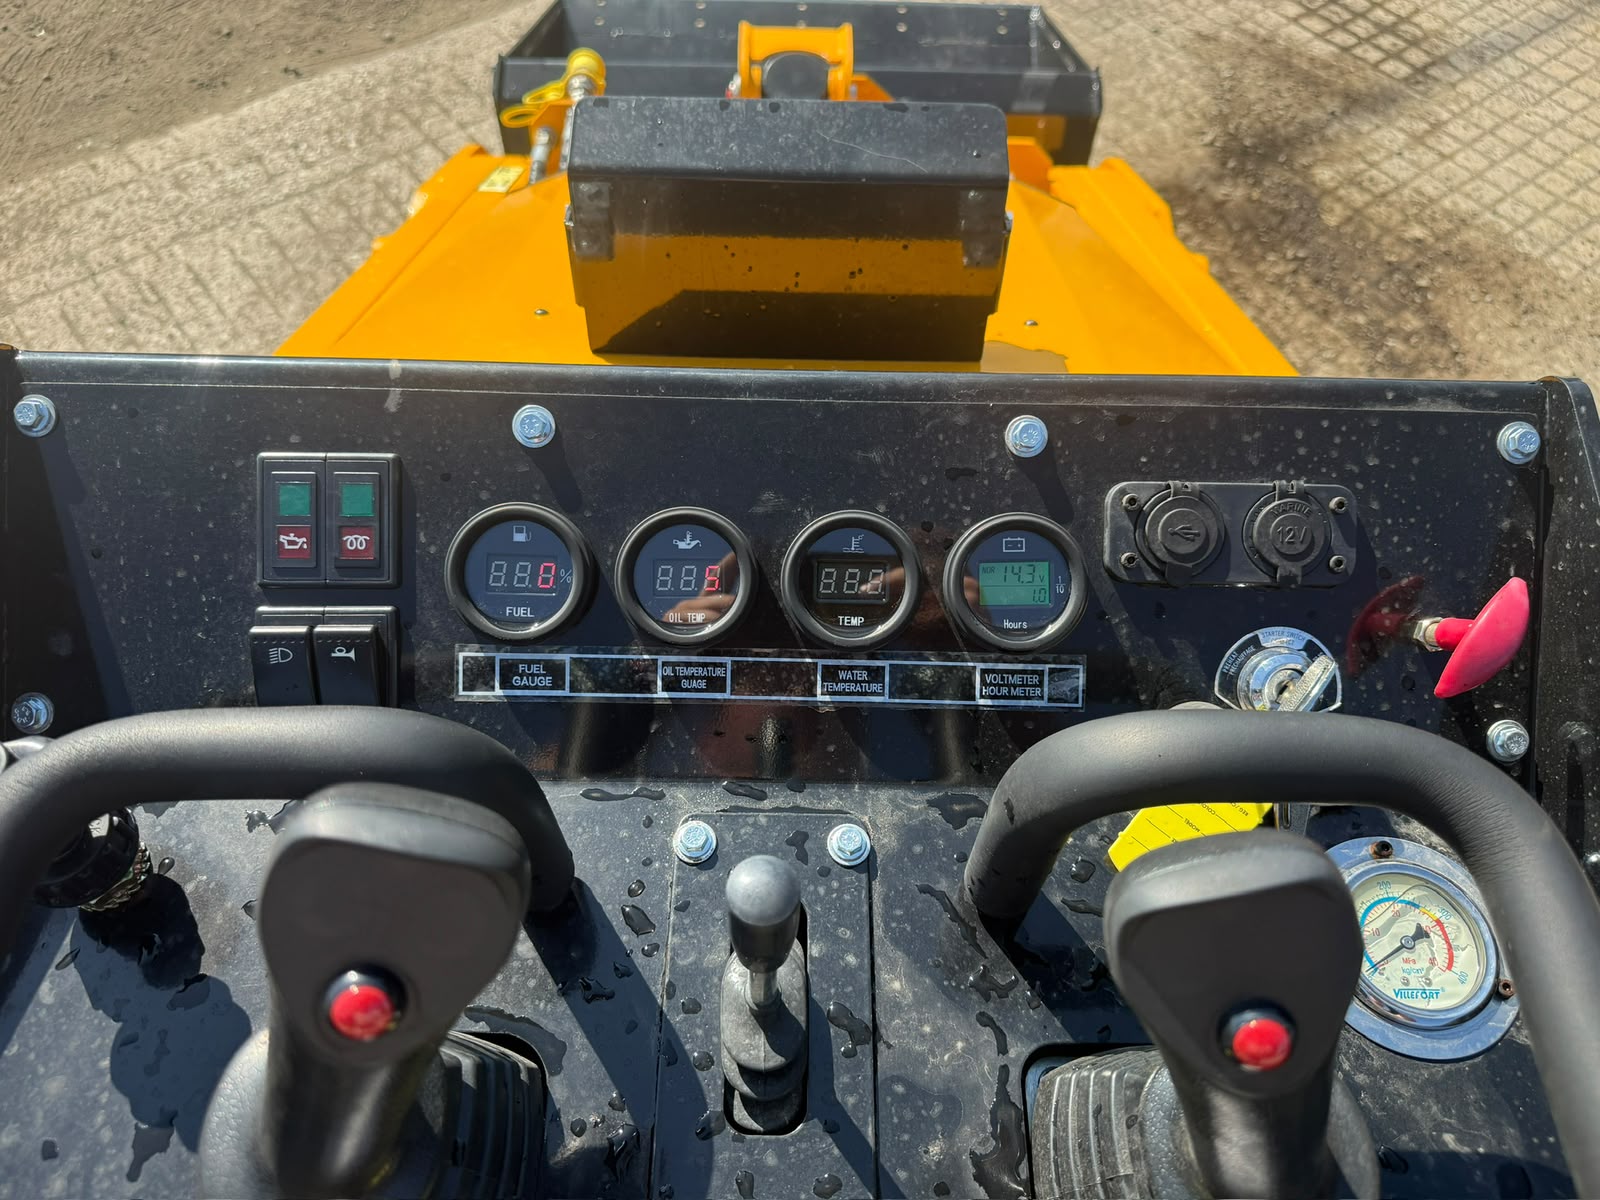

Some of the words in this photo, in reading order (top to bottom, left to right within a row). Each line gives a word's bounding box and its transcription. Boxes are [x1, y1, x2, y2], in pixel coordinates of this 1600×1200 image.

[1271, 502, 1312, 518] MARINE
[1276, 526, 1307, 545] 12V
[1003, 564, 1036, 584] 14.3
[506, 606, 535, 618] FUEL
[669, 612, 683, 623] OIL
[687, 612, 706, 623] TEMP
[838, 615, 865, 626] TEMP
[1003, 619, 1028, 629] Hours
[1262, 630, 1285, 638] STARTER
[1286, 631, 1306, 641] SWITCH
[518, 663, 547, 674] FUEL
[662, 666, 674, 676] OIL
[675, 666, 726, 677] TEMPERATURE
[838, 670, 868, 681] WATER
[985, 673, 1040, 685] VOLTMETER
[512, 676, 553, 687] GAUGE
[681, 679, 707, 689] GUAGE
[823, 682, 883, 693] TEMPERATURE
[982, 686, 1009, 696] HOUR
[1010, 687, 1042, 697] METER
[1392, 988, 1441, 1000] VILLEFORT
